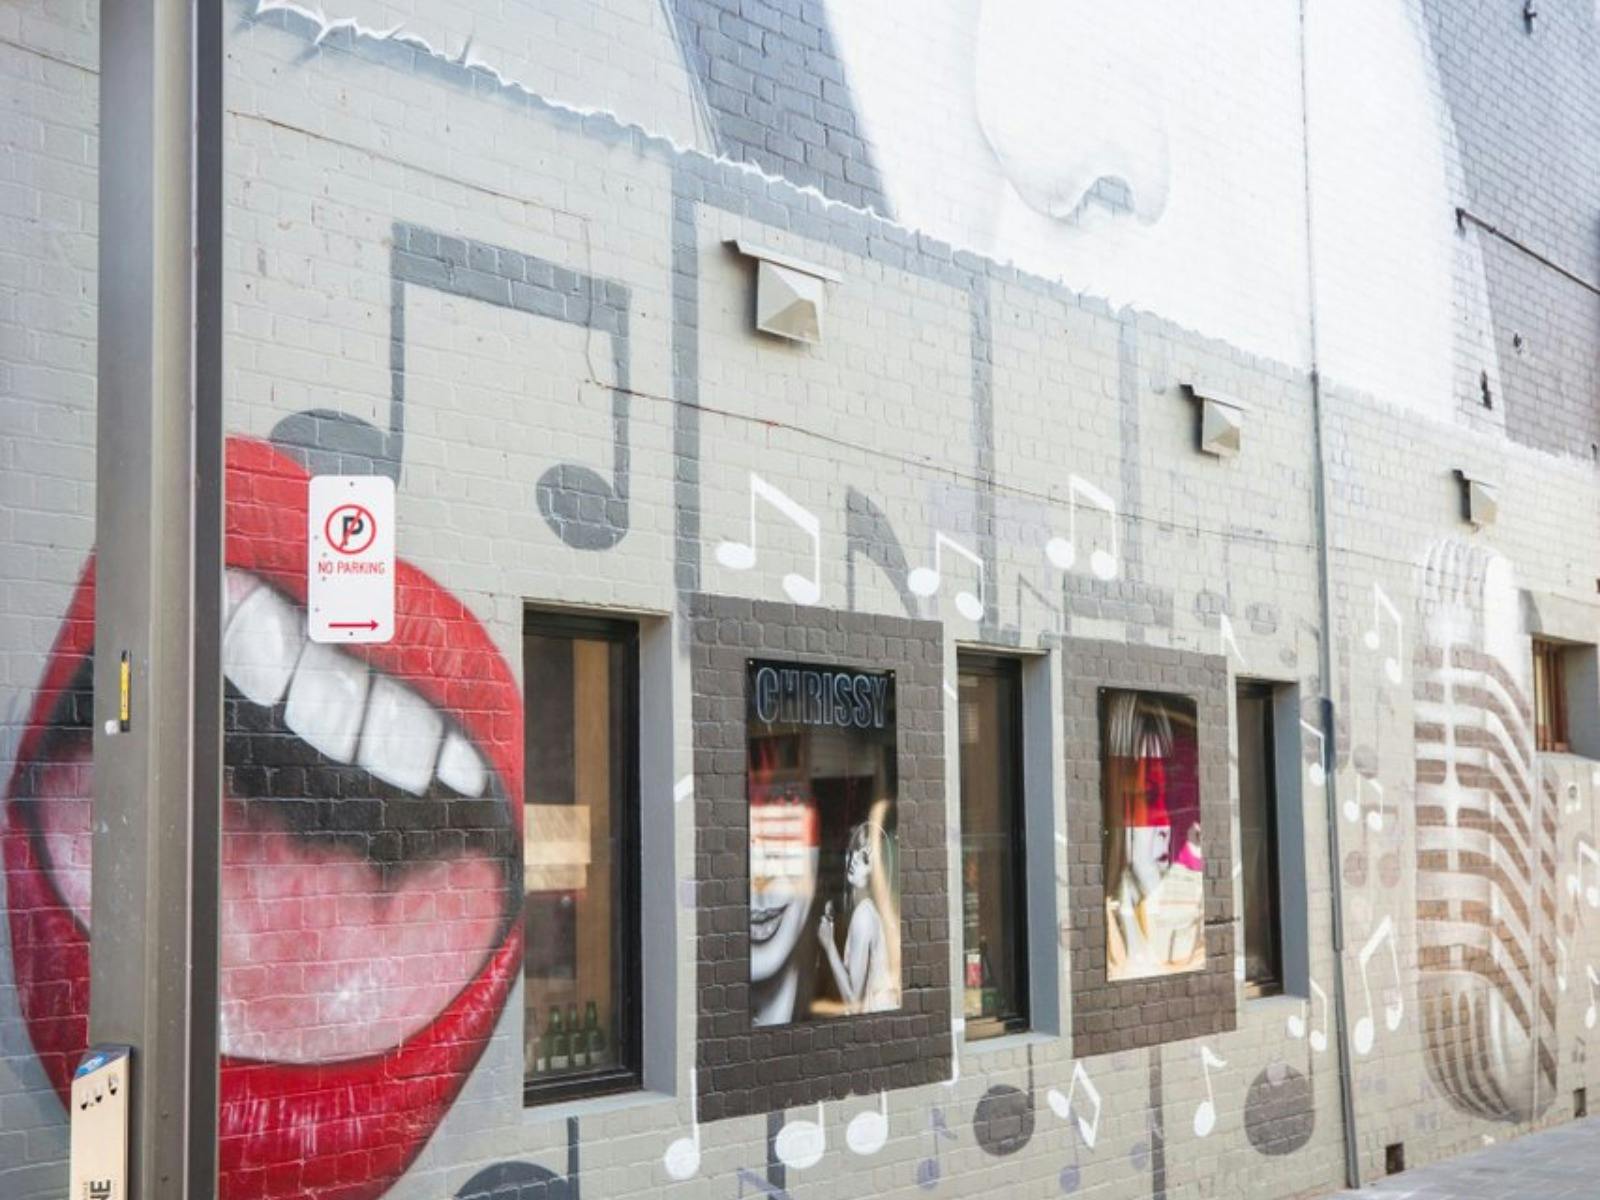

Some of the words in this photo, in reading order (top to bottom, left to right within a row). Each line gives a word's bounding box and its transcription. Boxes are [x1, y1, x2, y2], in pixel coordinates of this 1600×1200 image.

[342, 515, 364, 546] P
[318, 561, 333, 574] NO
[337, 561, 385, 575] PARKING
[757, 667, 888, 728] CHRISSY
